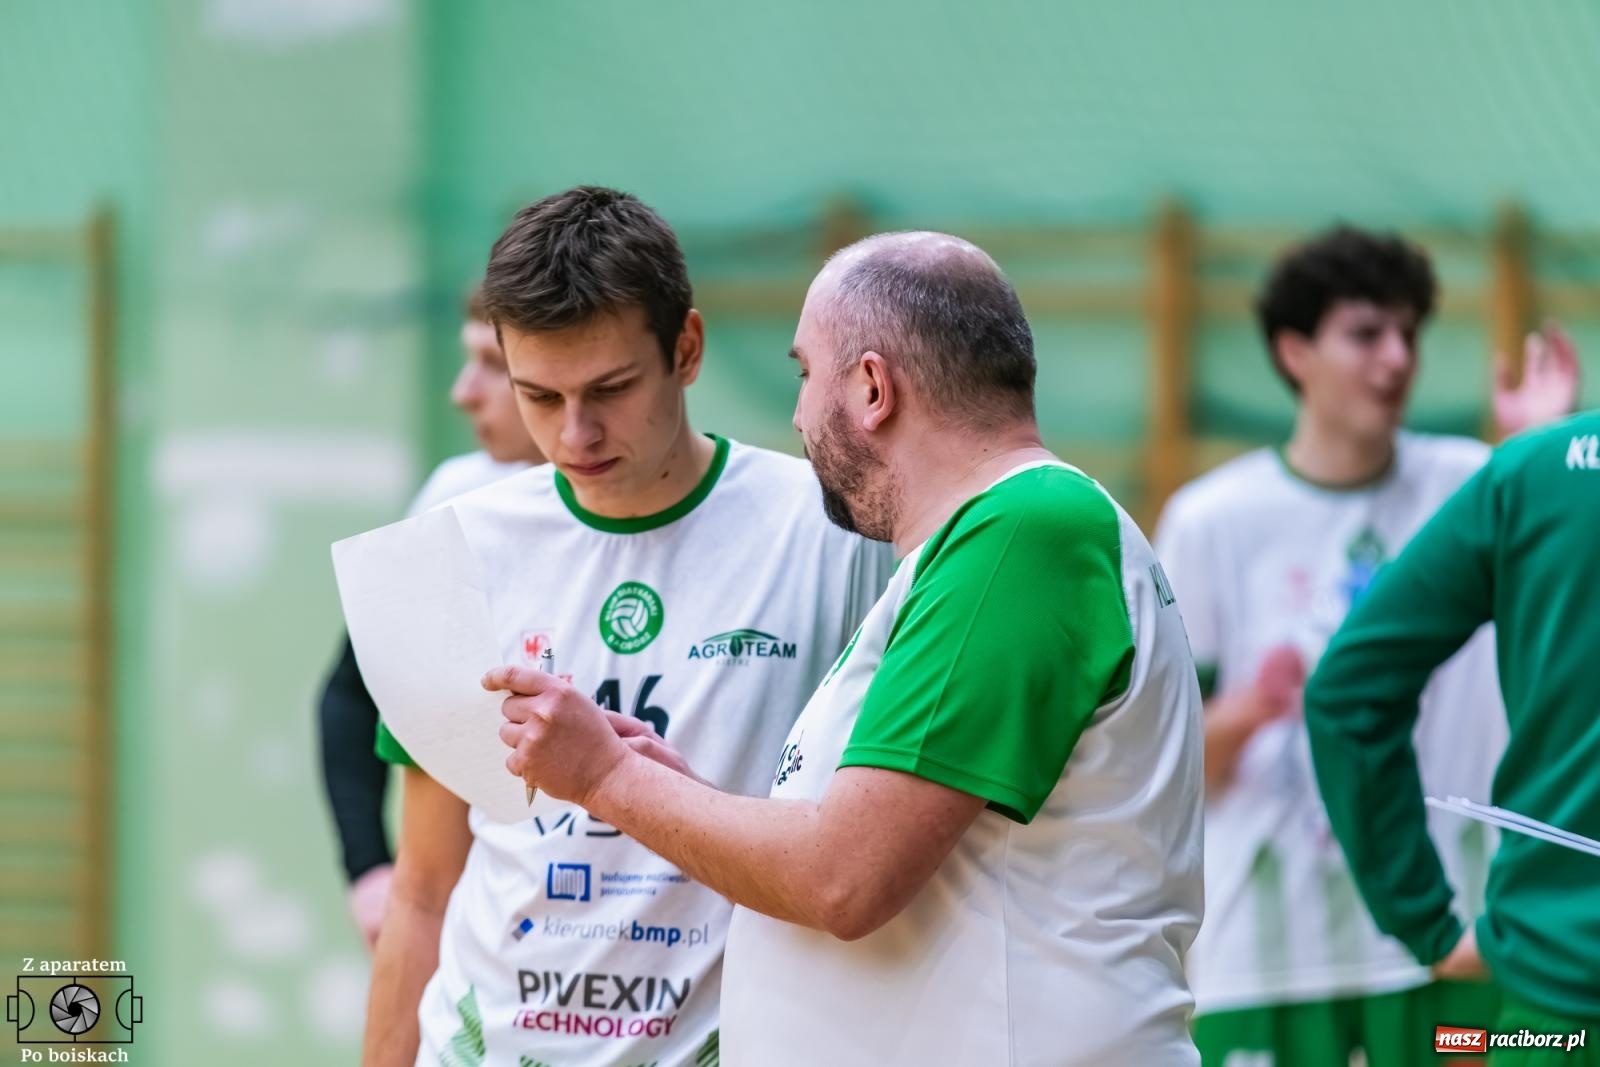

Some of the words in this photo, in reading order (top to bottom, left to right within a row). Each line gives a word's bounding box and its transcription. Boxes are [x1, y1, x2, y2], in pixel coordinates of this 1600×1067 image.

[1566, 434, 1600, 470] KL
[543, 915, 709, 948] kierunekbmp.pl
[518, 970, 691, 1012] PIVEXIN
[513, 1010, 677, 1038] TECHNOLOGY
